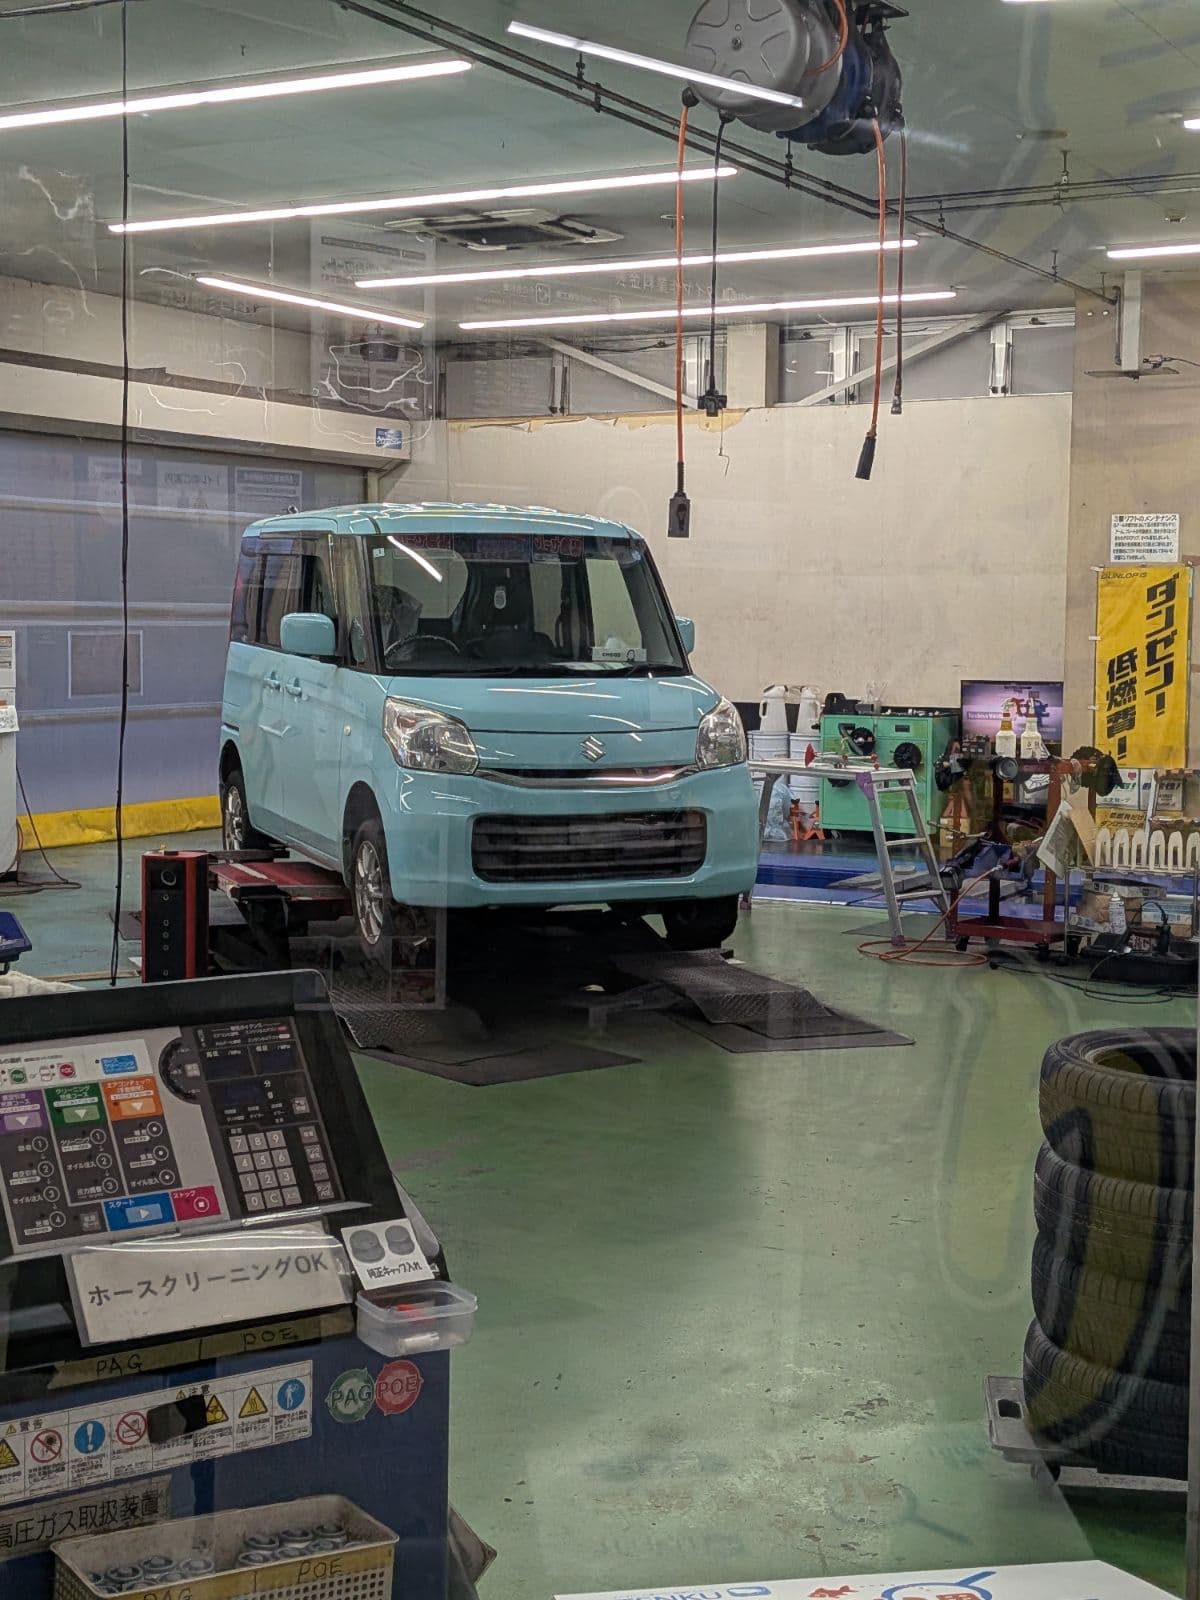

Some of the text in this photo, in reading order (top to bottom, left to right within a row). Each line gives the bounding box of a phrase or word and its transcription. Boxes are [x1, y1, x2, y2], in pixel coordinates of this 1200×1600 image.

[254, 1137, 262, 1146] 8
[272, 1134, 279, 1143] 9
[241, 1153, 285, 1167] 4 5 6
[265, 1174, 272, 1184] 2
[283, 1172, 290, 1181] 3
[108, 1199, 135, 1209] スタート
[173, 1190, 196, 1199] ストップ
[88, 1252, 329, 1306] ホースクリーニングOK
[242, 1327, 298, 1350] POE
[96, 1354, 143, 1377] PAG
[331, 1384, 372, 1409] PAG
[379, 1373, 419, 1401] POE
[0, 1489, 159, 1548] 高圧ガス取扱装置
[297, 1557, 344, 1585] POE
